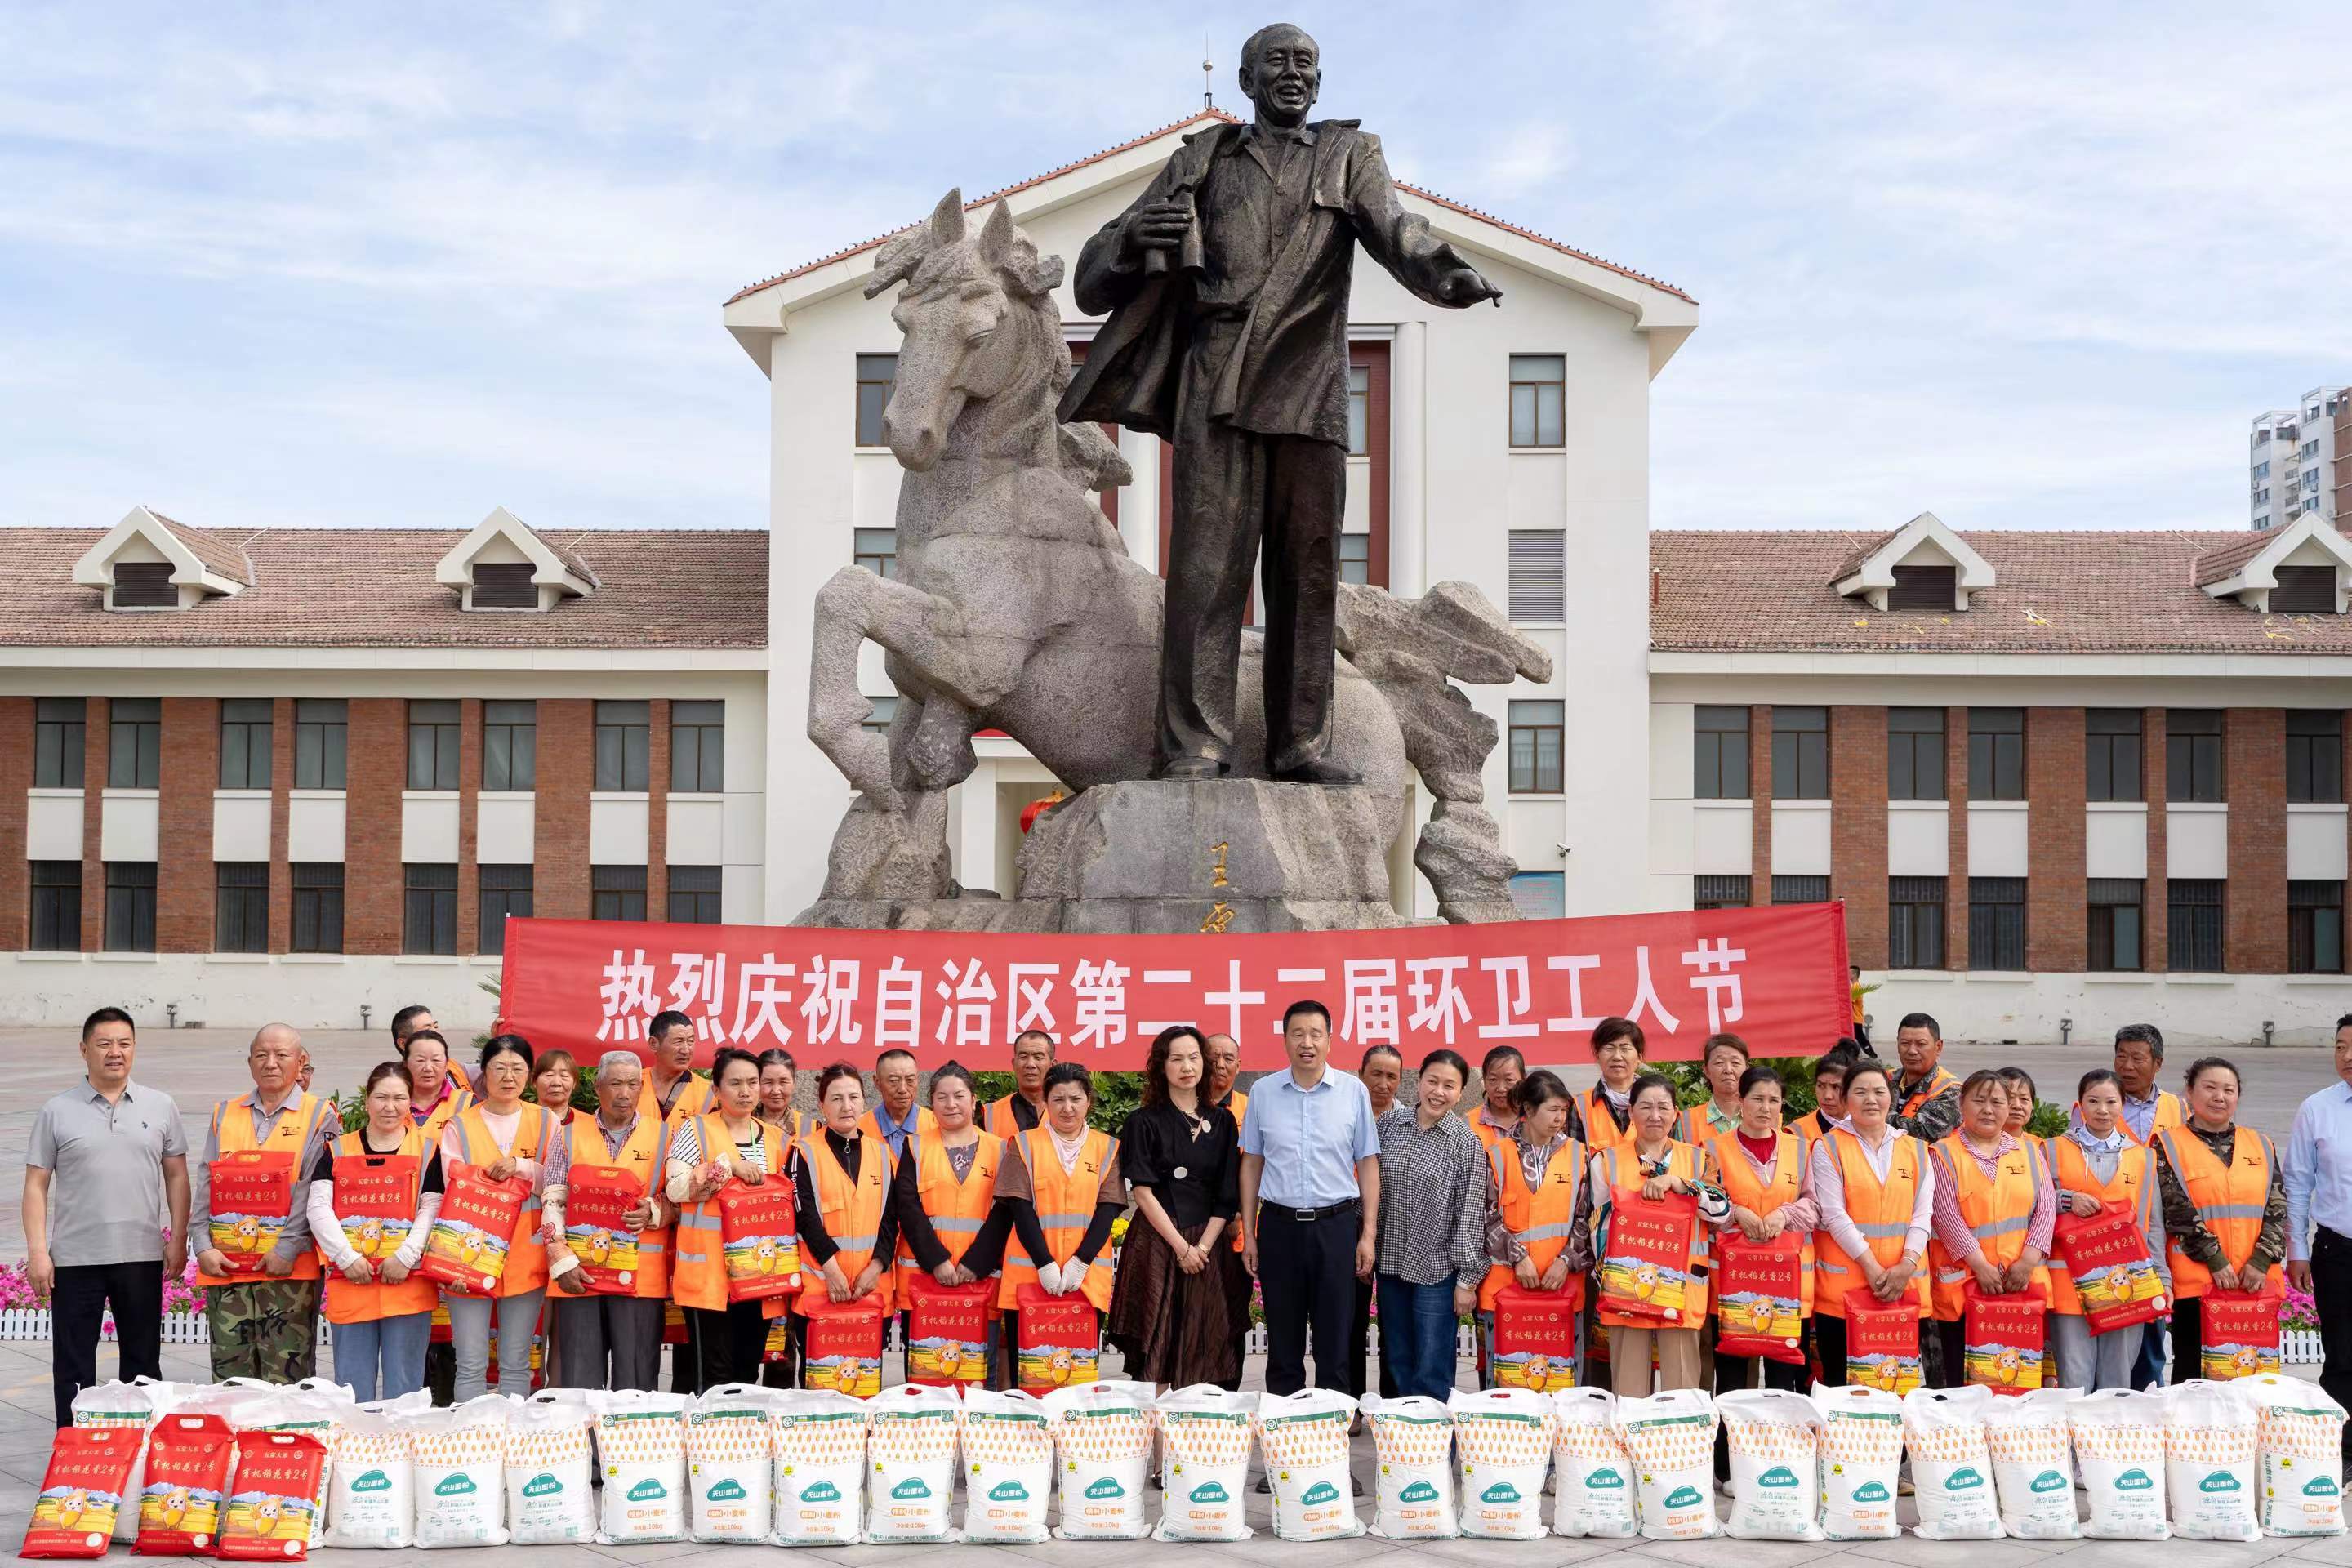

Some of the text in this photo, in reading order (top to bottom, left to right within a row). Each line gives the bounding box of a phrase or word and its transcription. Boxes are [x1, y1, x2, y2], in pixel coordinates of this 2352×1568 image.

[595, 937, 1747, 1048] 热烈庆祝自治区第二十二届环卫工人节
